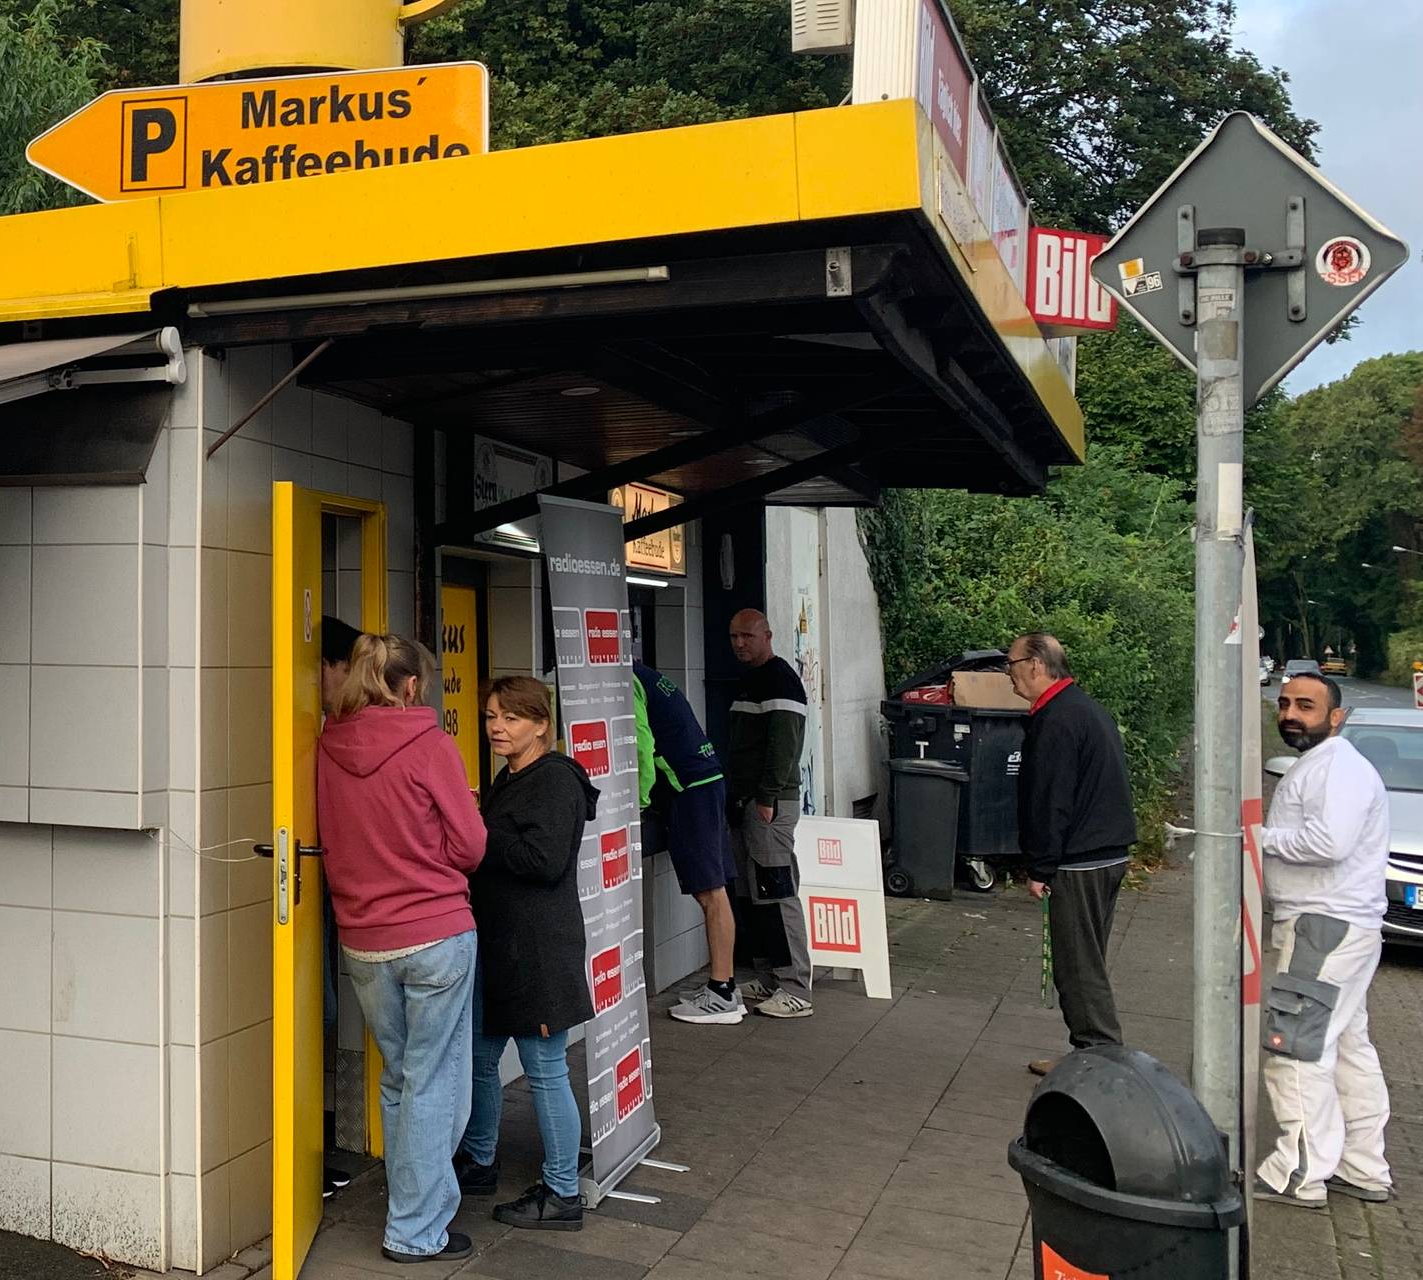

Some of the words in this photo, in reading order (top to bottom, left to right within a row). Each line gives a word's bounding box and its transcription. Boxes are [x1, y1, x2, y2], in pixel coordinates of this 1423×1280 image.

[131, 107, 176, 182] P
[1148, 275, 1160, 289] 96
[550, 552, 621, 577] radioessen.de
[818, 840, 841, 859] Bild
[812, 902, 857, 946] Bild
